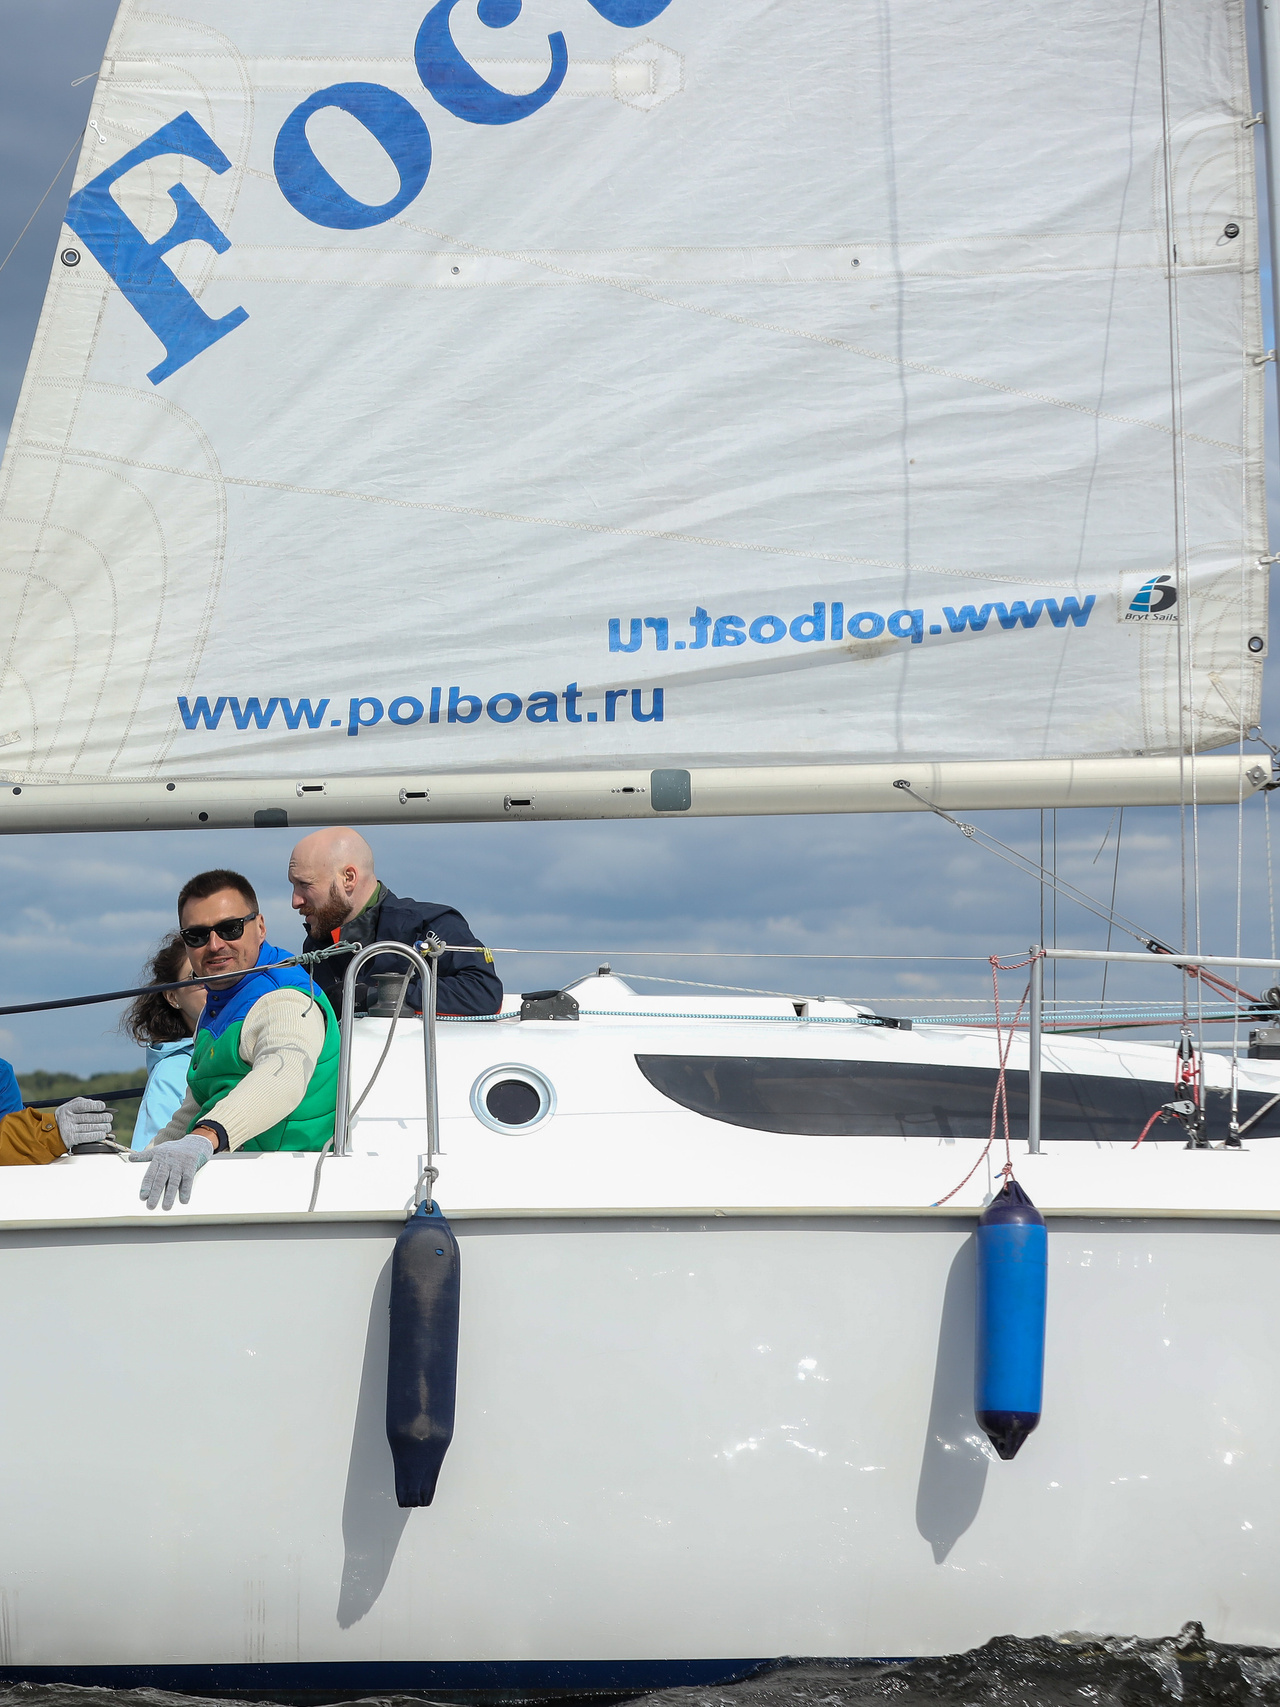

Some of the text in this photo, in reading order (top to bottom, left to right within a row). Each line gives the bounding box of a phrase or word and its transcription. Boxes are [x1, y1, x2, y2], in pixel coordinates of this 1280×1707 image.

[64, 0, 672, 385] Foc
[1125, 613, 1179, 621] Bryt Sails
[177, 683, 664, 736] www.polboat.ru
